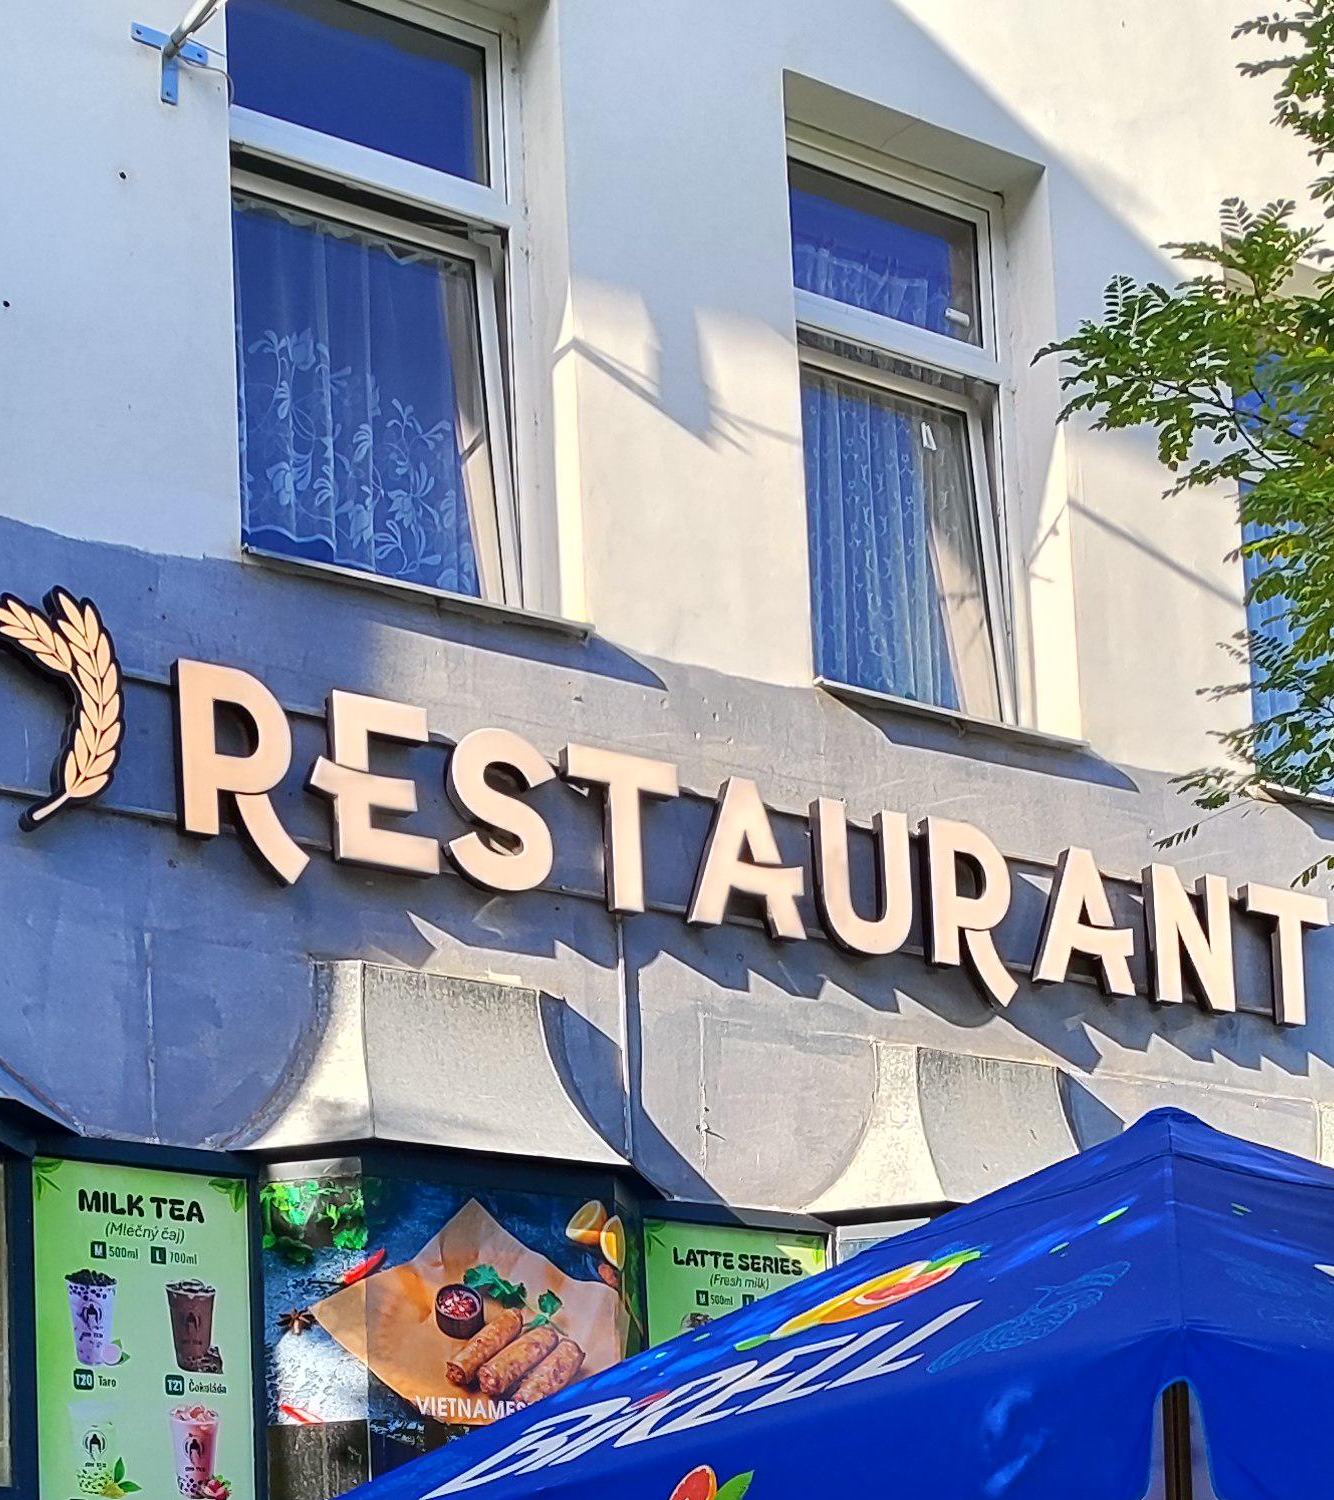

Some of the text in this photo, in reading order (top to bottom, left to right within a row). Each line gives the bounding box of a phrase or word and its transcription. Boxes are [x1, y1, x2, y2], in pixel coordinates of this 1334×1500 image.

[172, 658, 1329, 1027] RESTAURANT
[78, 1189, 205, 1223] MILK TEA
[108, 1246, 139, 1259] 500ml
[672, 1246, 803, 1276] LATTE SERIES
[709, 1273, 770, 1291] (Fresh milk)
[98, 1375, 117, 1388] Taro
